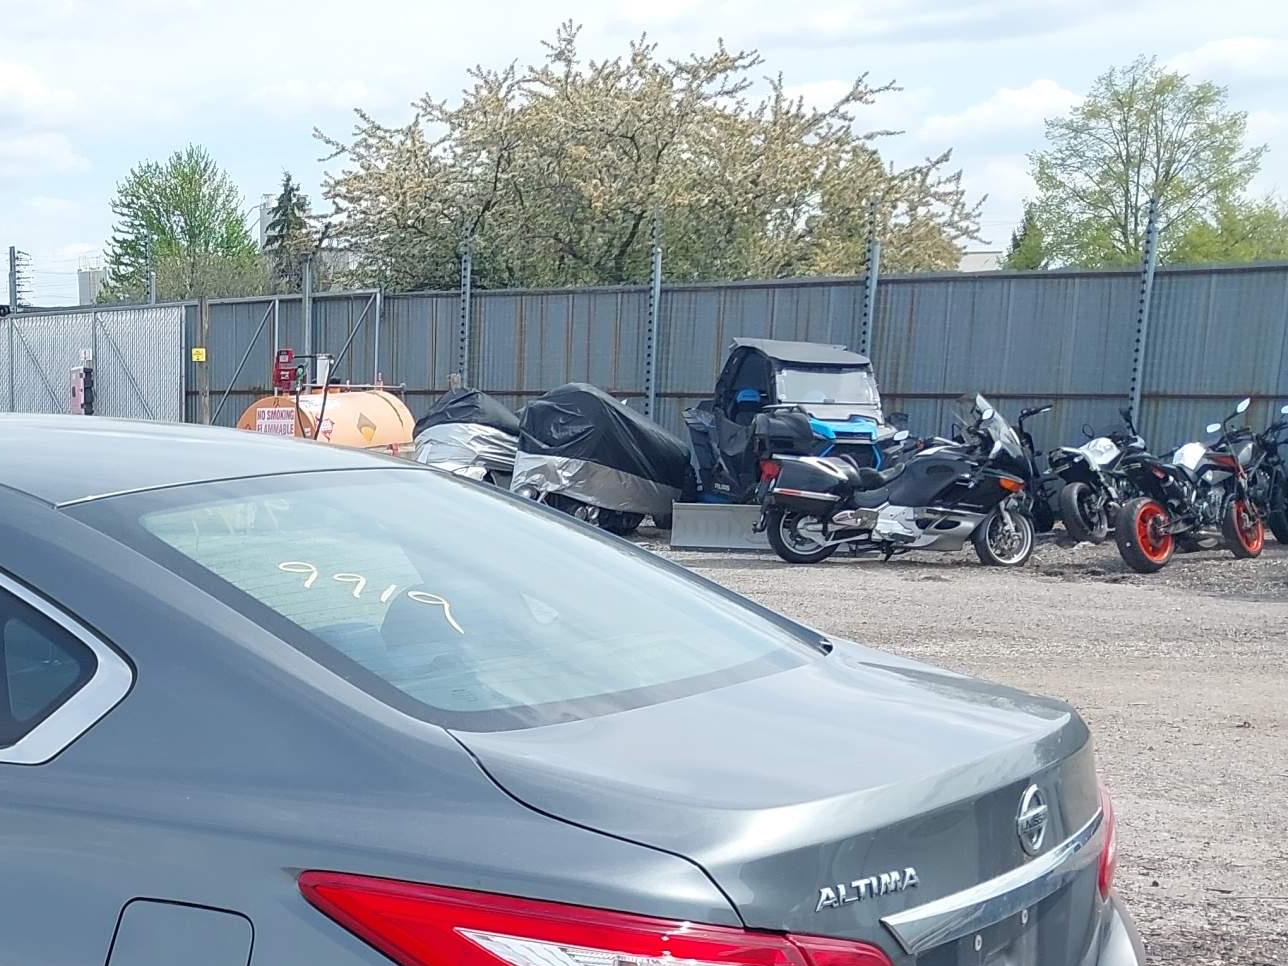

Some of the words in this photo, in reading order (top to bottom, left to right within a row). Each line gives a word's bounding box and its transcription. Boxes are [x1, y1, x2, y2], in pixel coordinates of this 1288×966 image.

[257, 410, 266, 420] NO
[267, 410, 295, 420] SMOKING
[278, 561, 465, 635] 9919
[816, 866, 920, 912] ALTIMA
